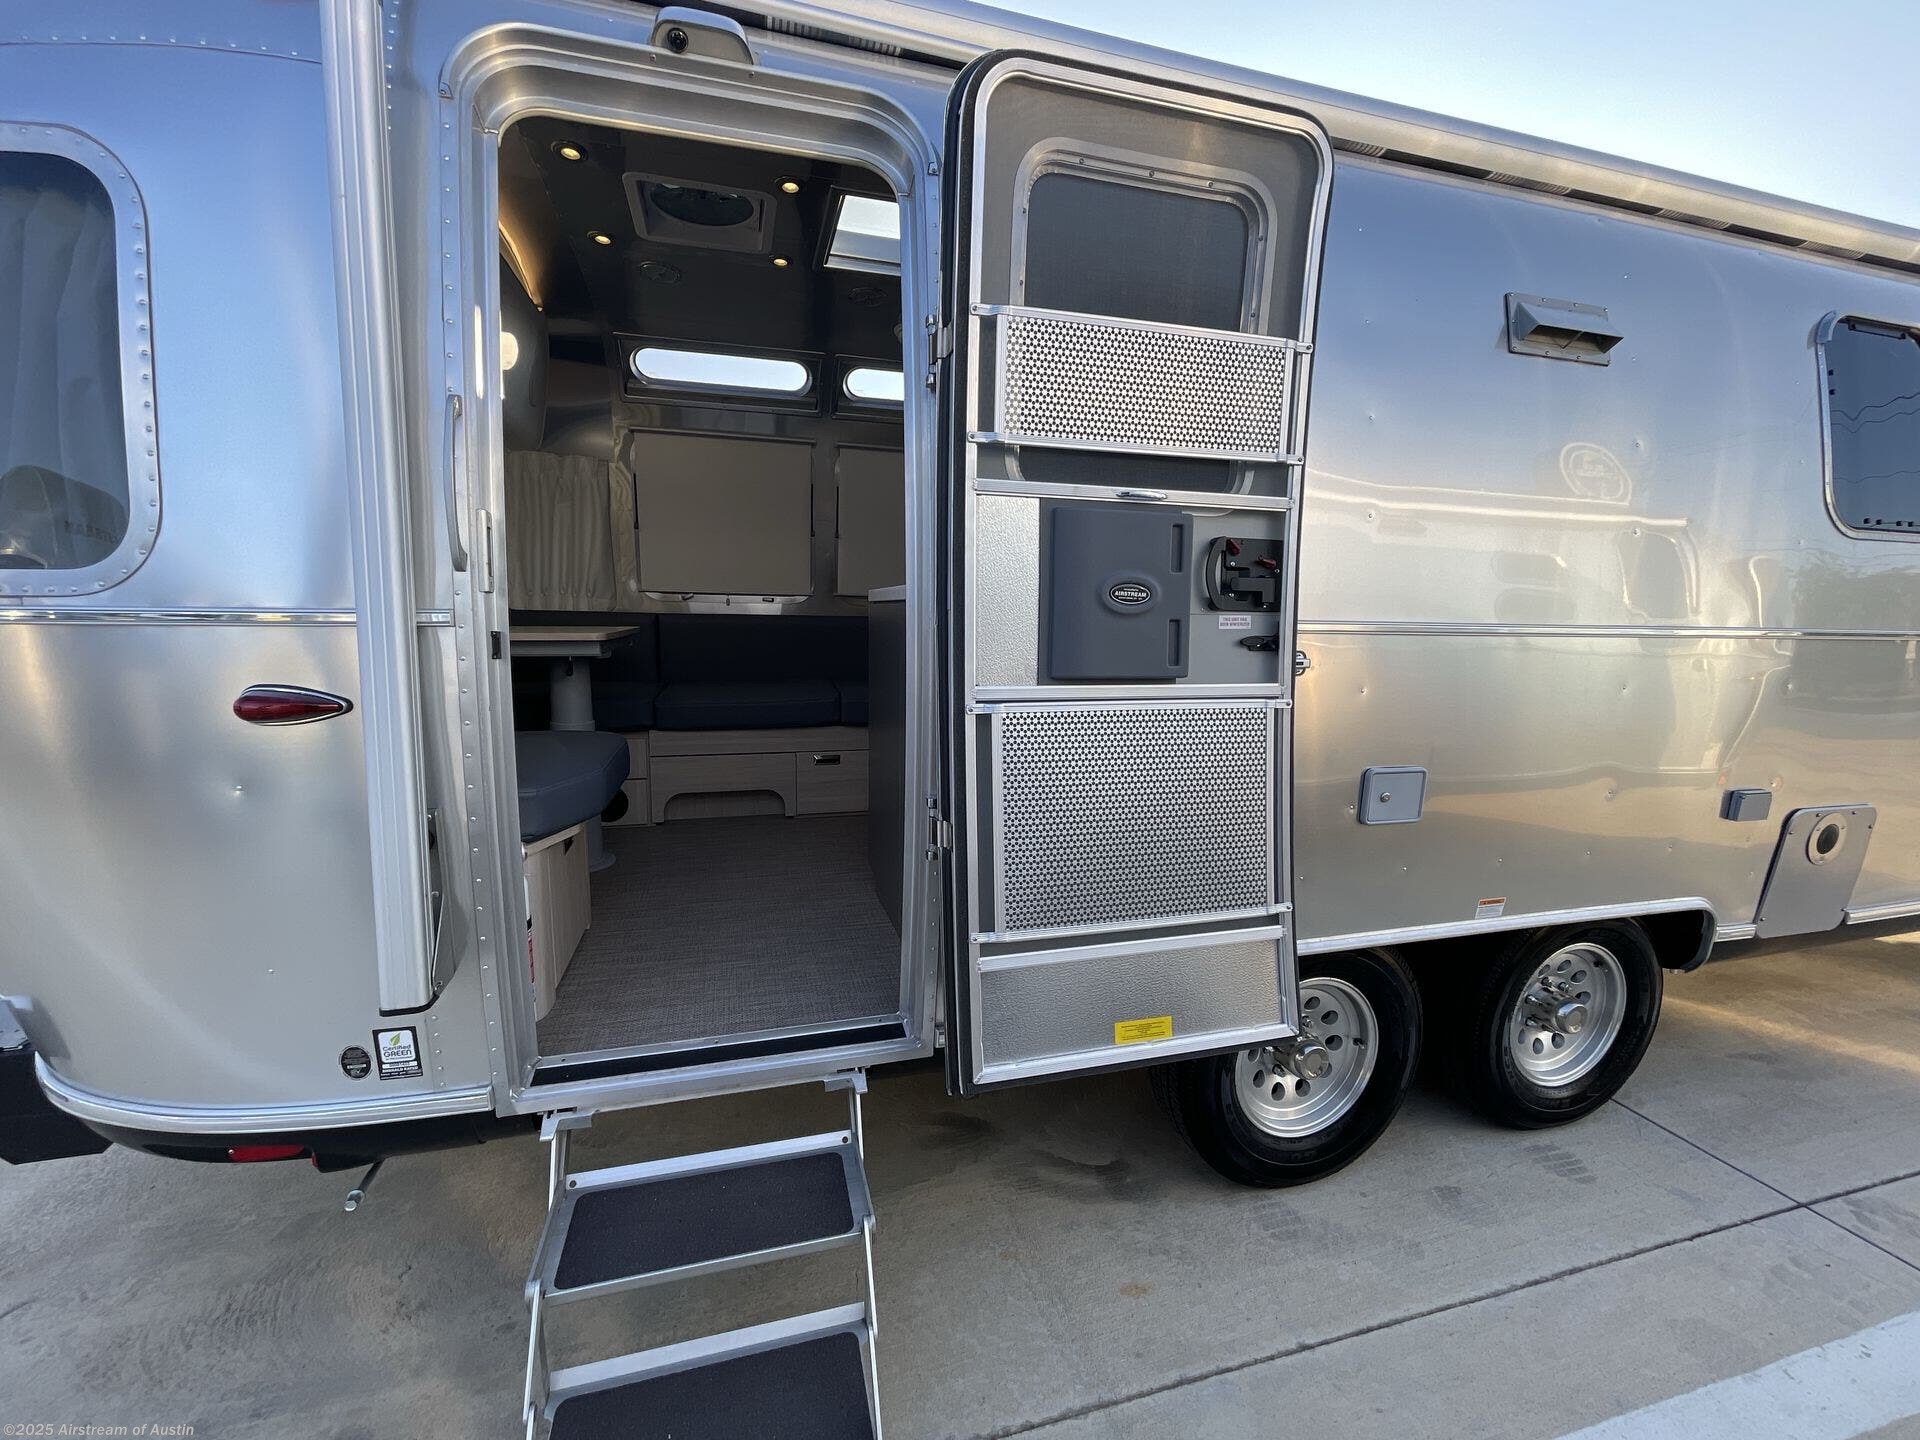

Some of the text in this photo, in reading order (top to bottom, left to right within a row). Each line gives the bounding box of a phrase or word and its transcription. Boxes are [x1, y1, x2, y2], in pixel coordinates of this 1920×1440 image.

[1114, 590, 1147, 598] AIRSTREAM
[382, 1044, 411, 1052] Certified
[383, 1049, 412, 1058] GREEN
